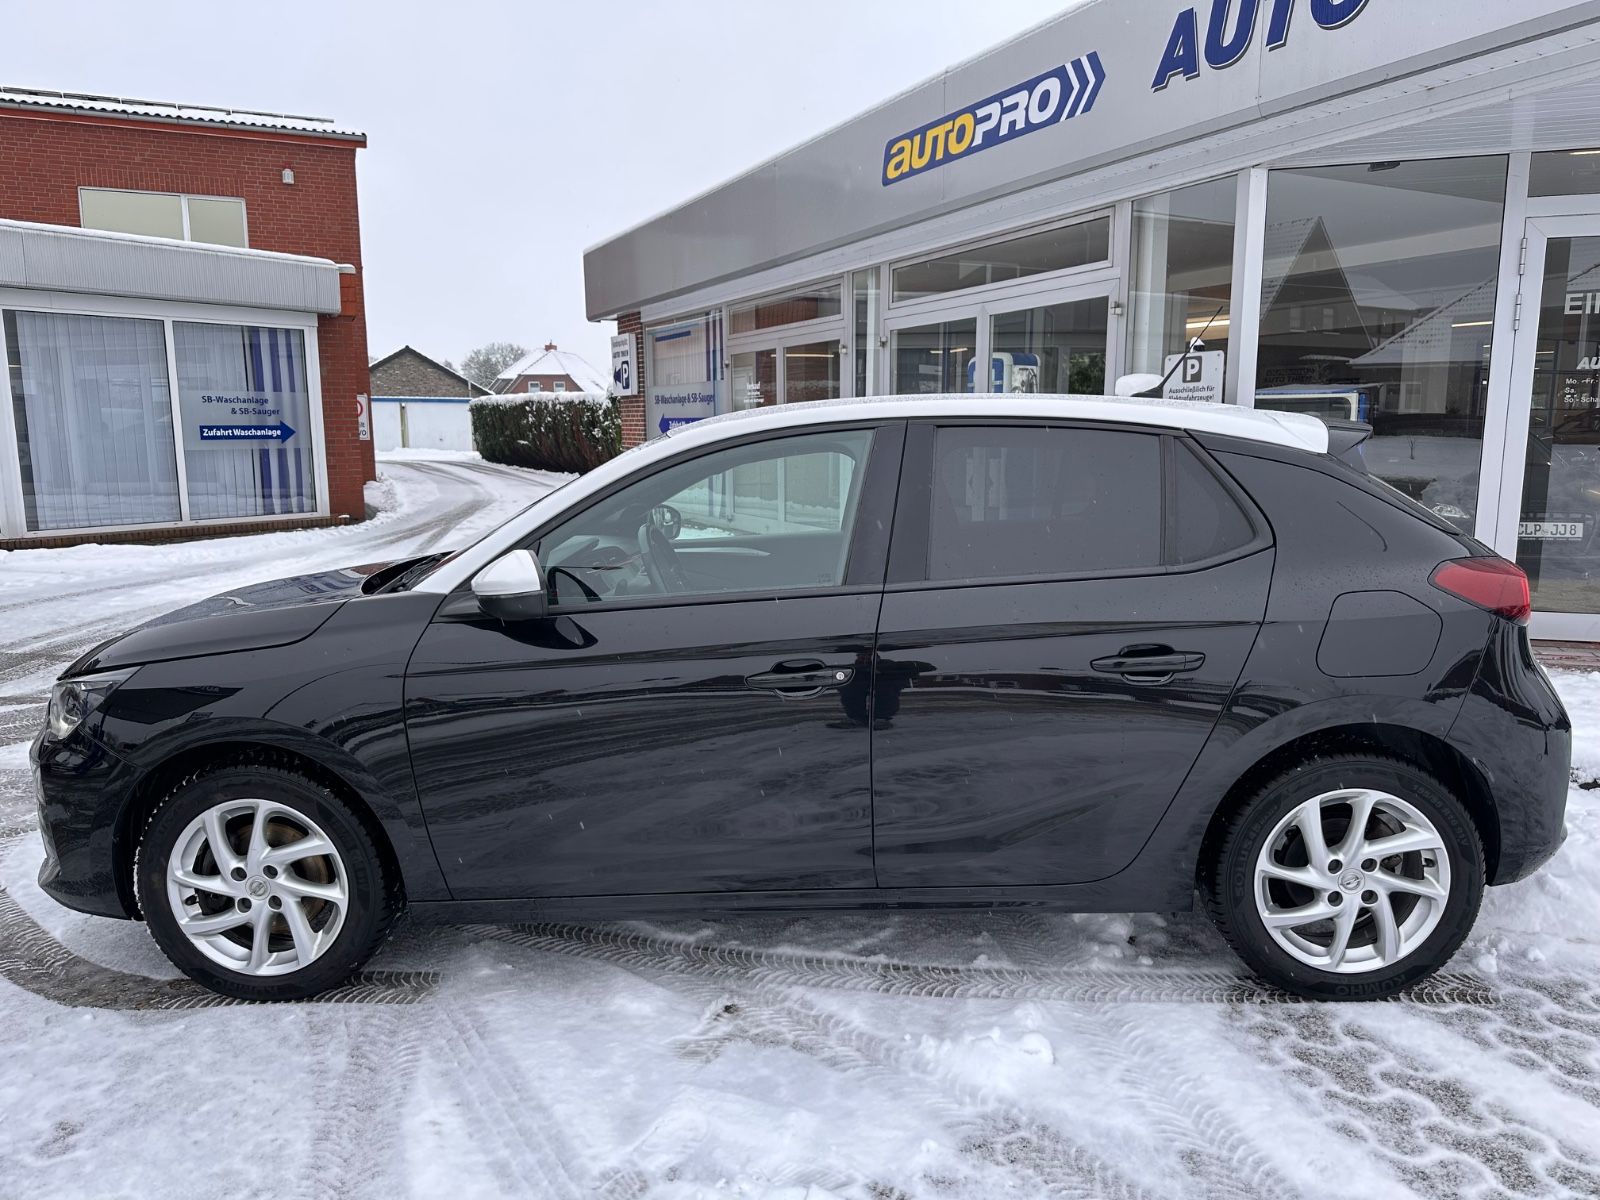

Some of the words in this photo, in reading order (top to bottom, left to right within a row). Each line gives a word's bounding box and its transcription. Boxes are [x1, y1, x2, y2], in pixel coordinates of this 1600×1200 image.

[1186, 359, 1200, 381] P
[1169, 386, 1206, 394] Ausschließlich
[201, 395, 269, 405] SB-Waschanlage
[655, 393, 686, 406] SB-Waschanlage
[231, 407, 237, 415] &
[239, 407, 280, 416] SB-Sauger
[233, 429, 281, 437] Waschanlage
[1518, 524, 1542, 536] CLP
[1335, 974, 1406, 996] KUMHO
